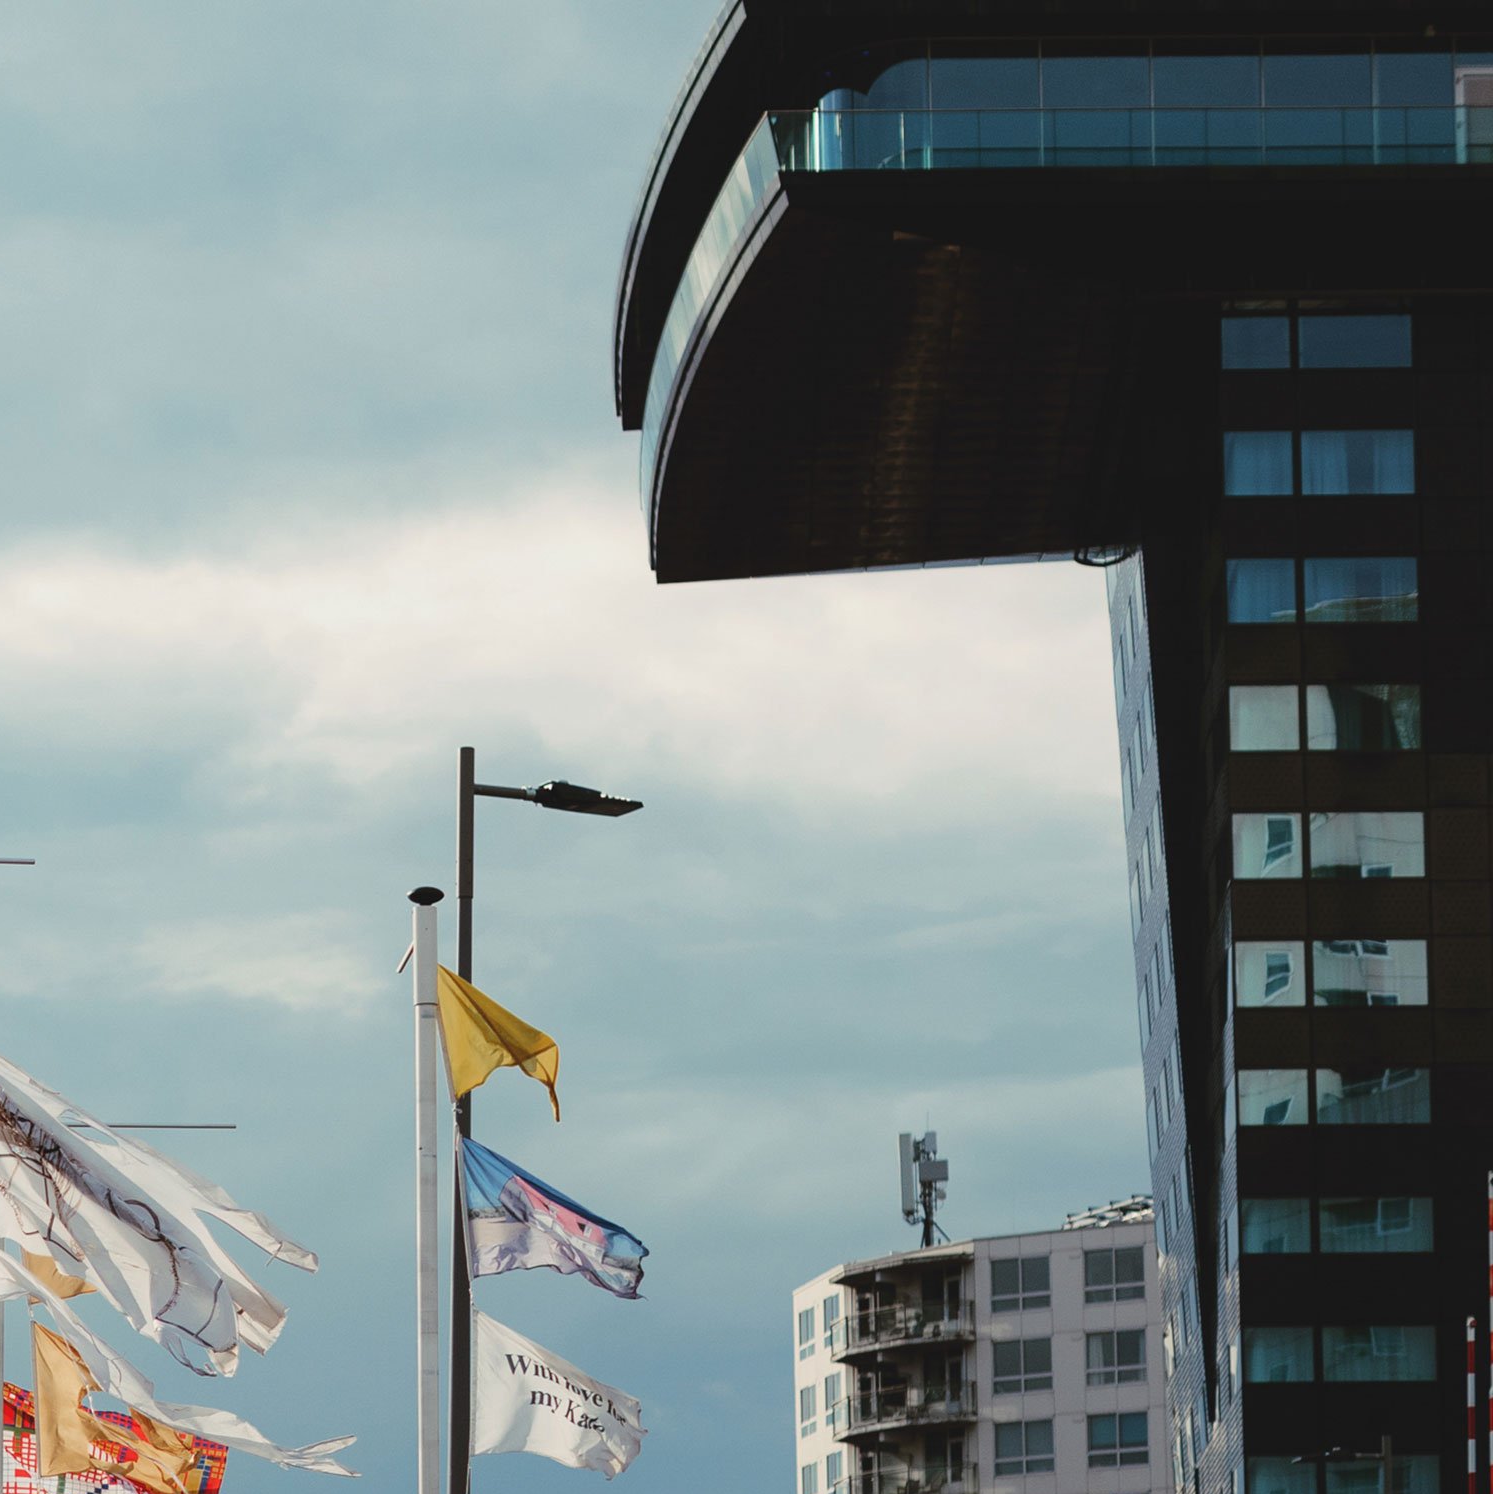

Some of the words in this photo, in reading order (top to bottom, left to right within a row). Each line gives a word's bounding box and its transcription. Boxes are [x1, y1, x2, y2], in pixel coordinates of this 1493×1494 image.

[505, 1354, 560, 1384] With
[563, 1376, 604, 1407] love
[530, 1390, 562, 1413] my
